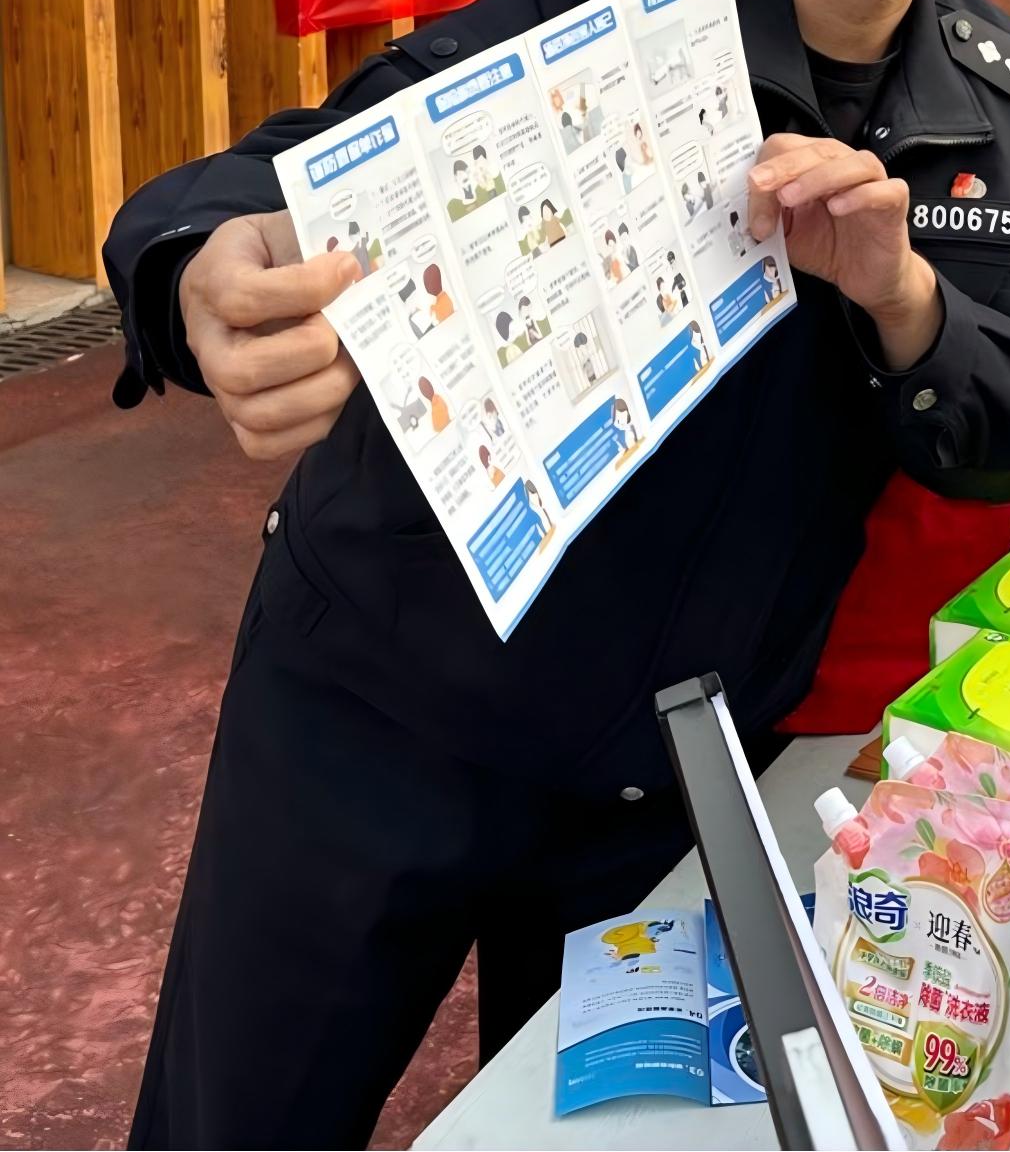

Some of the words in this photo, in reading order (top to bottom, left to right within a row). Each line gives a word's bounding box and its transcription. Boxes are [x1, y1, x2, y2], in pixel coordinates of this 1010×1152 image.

[848, 881, 908, 930] 浪奇
[926, 910, 972, 951] 迎春
[924, 1032, 968, 1075] 99%
